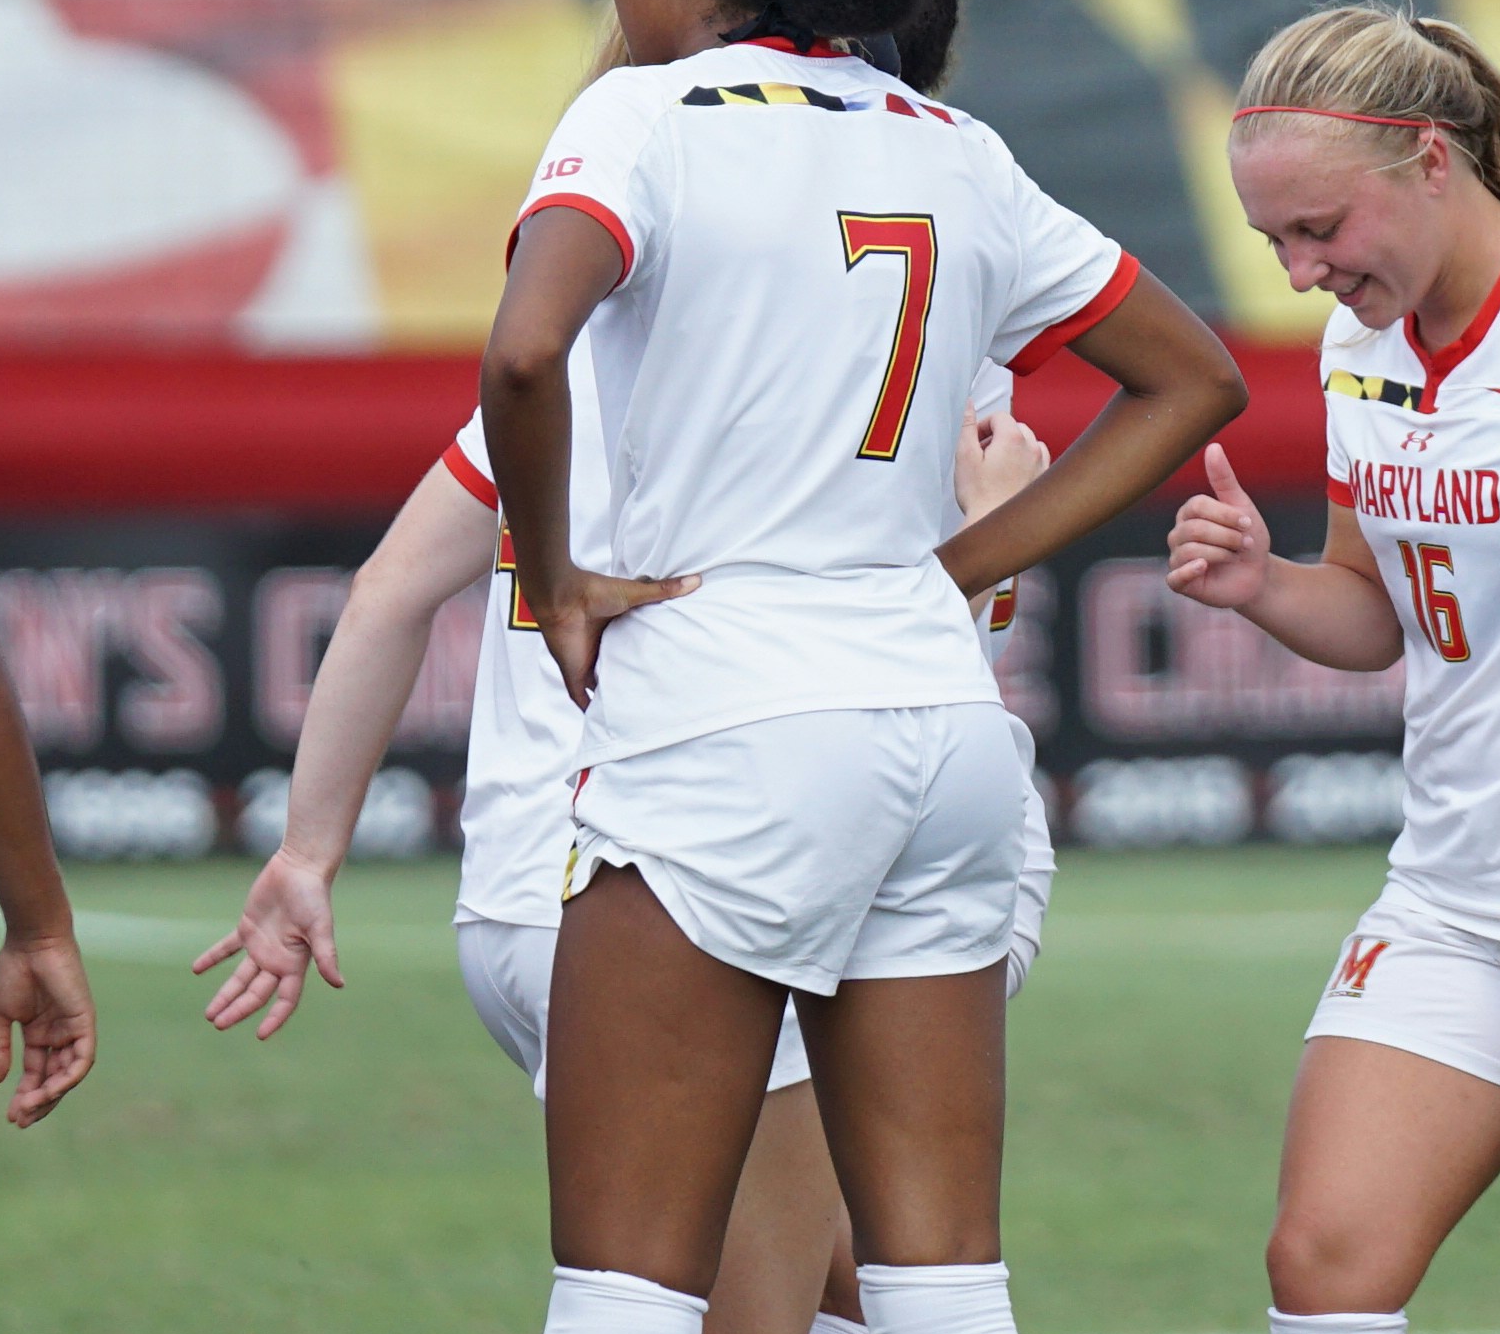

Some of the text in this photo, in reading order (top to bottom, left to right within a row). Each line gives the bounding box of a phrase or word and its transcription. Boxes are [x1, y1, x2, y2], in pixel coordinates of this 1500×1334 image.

[836, 210, 937, 462] 7
[1350, 459, 1500, 525] MARYLAND
[1396, 539, 1471, 663] 16
